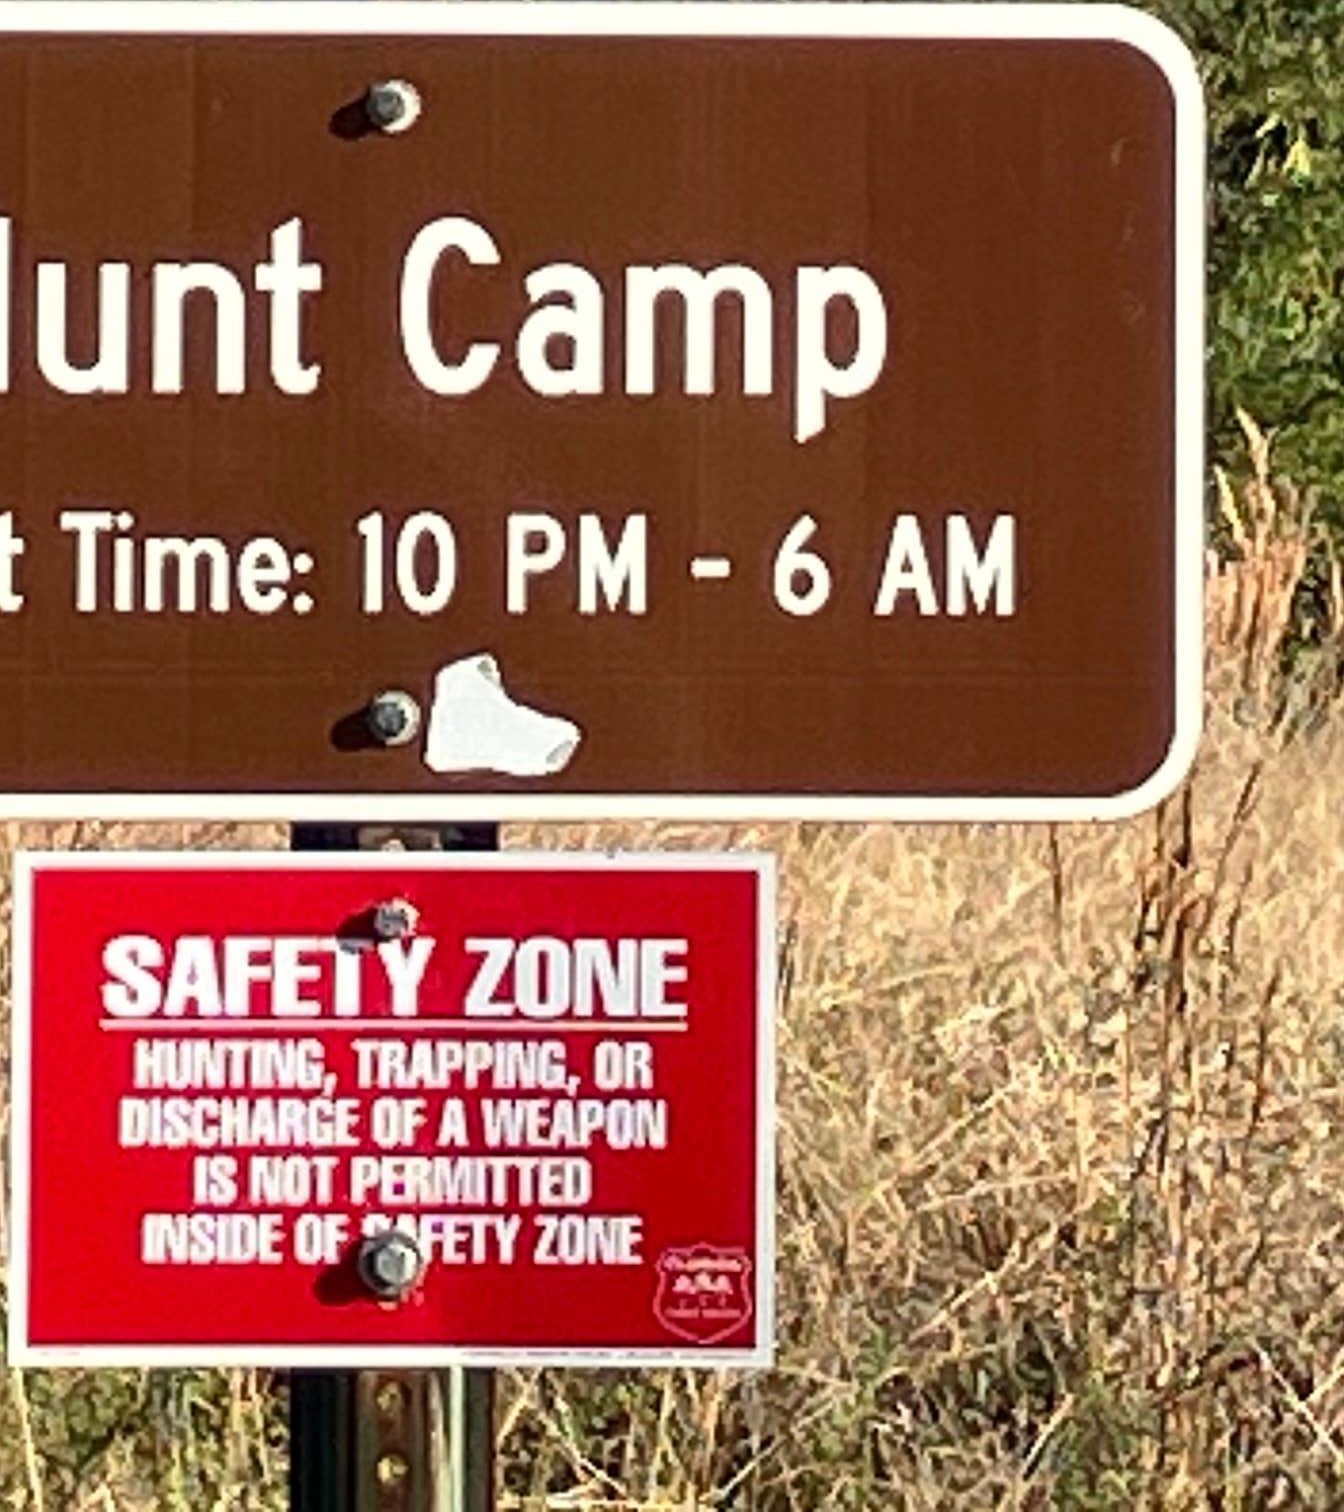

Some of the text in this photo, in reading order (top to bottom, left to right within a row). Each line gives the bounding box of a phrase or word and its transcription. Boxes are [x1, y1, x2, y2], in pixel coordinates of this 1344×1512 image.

[400, 217, 887, 444] Camp
[60, 511, 314, 615] Time:
[358, 511, 456, 615] 10
[507, 513, 648, 614] PM
[774, 515, 831, 616] 6
[874, 514, 1016, 616] AM
[101, 936, 688, 1017] SAFETY ZONE
[134, 1039, 653, 1096] HUNTING, TRAPPING, OR
[119, 1098, 667, 1149] DISCHARGE OF A WEAPON
[194, 1155, 592, 1206] IS NOT PERMITTED
[142, 1214, 285, 1264] INSIDE
[294, 1214, 349, 1265] OF
[533, 1215, 643, 1265] ZONE
